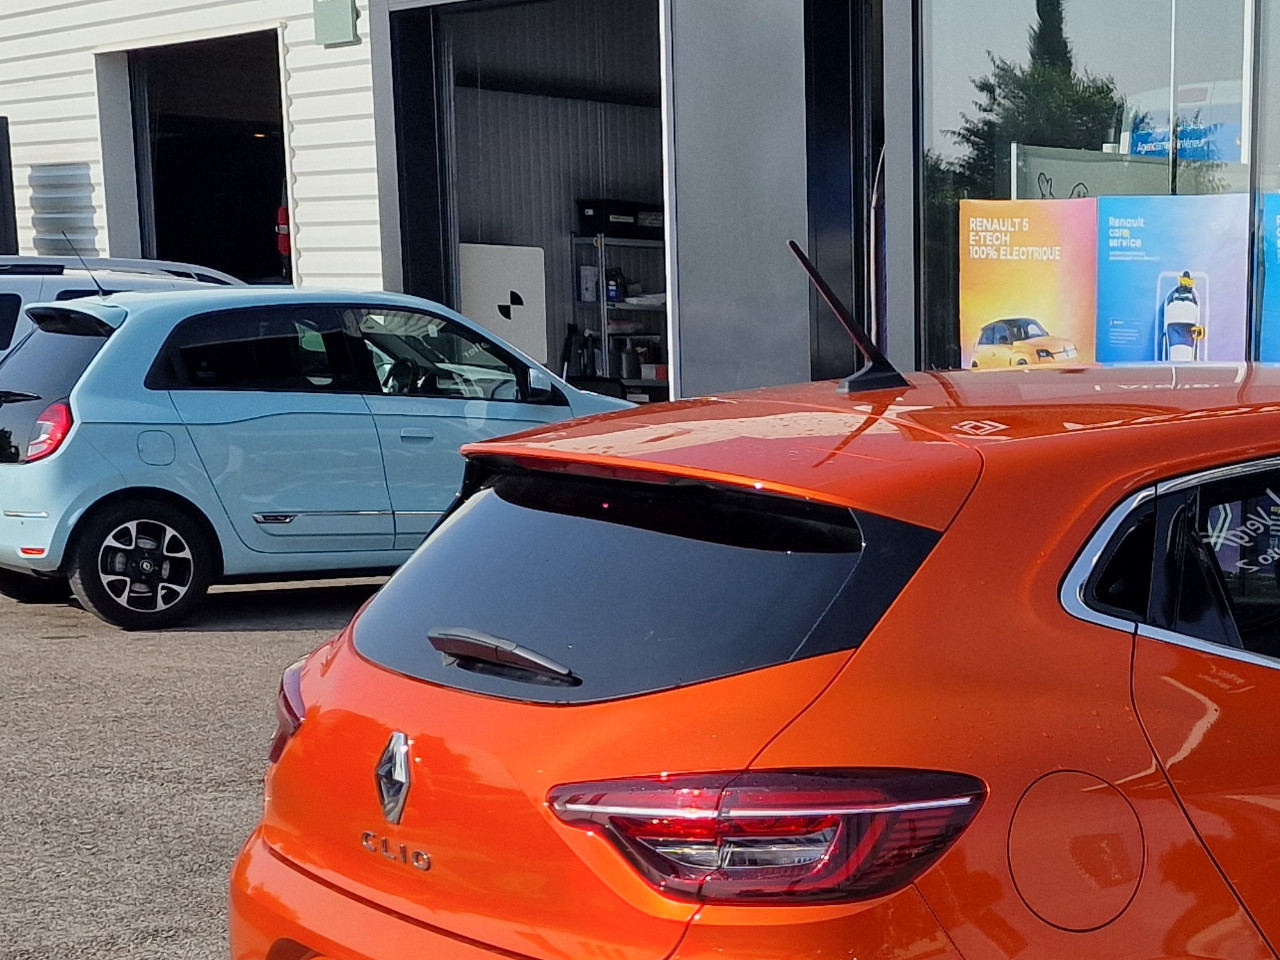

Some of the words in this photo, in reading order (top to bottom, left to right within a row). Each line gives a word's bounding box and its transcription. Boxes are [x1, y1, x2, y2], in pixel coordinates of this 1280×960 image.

[969, 218, 1020, 231] RENAULT
[1022, 218, 1029, 231] 5
[1108, 216, 1144, 228] Renault
[969, 232, 1010, 245] E-TECH
[1108, 237, 1142, 248] service
[969, 247, 997, 260] 100%
[1000, 247, 1061, 260] ELECTRIQUE
[361, 830, 431, 872] CLIO
